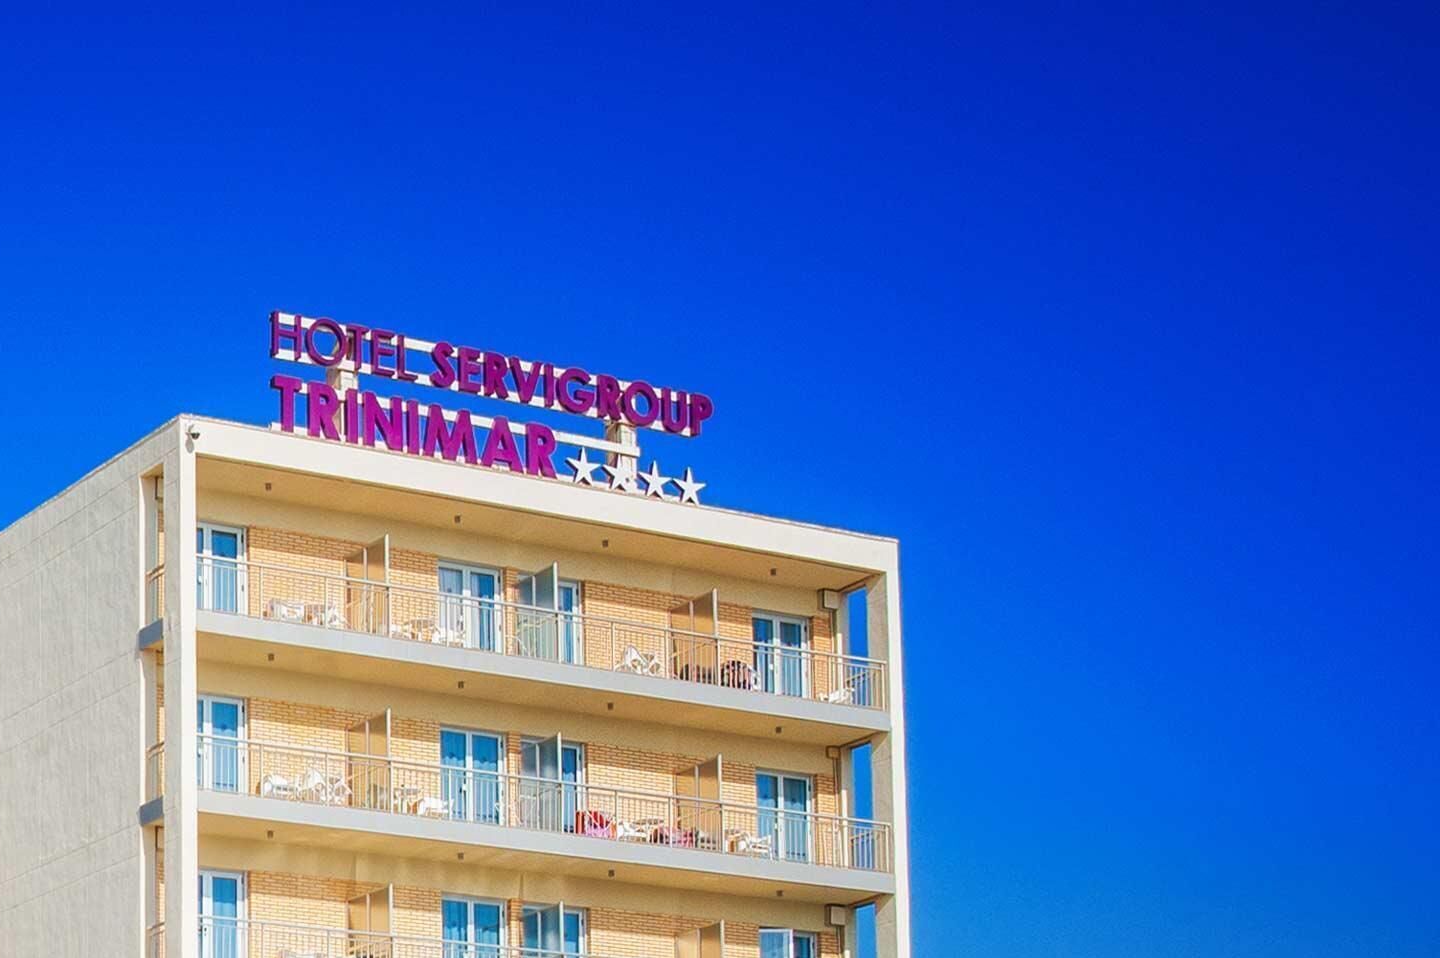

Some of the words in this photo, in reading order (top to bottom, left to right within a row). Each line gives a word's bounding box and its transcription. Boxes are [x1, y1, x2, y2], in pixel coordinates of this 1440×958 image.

[269, 310, 418, 382] HOTEL
[430, 341, 714, 437] SERVIGROUP
[270, 374, 558, 479] TRINIMAR
